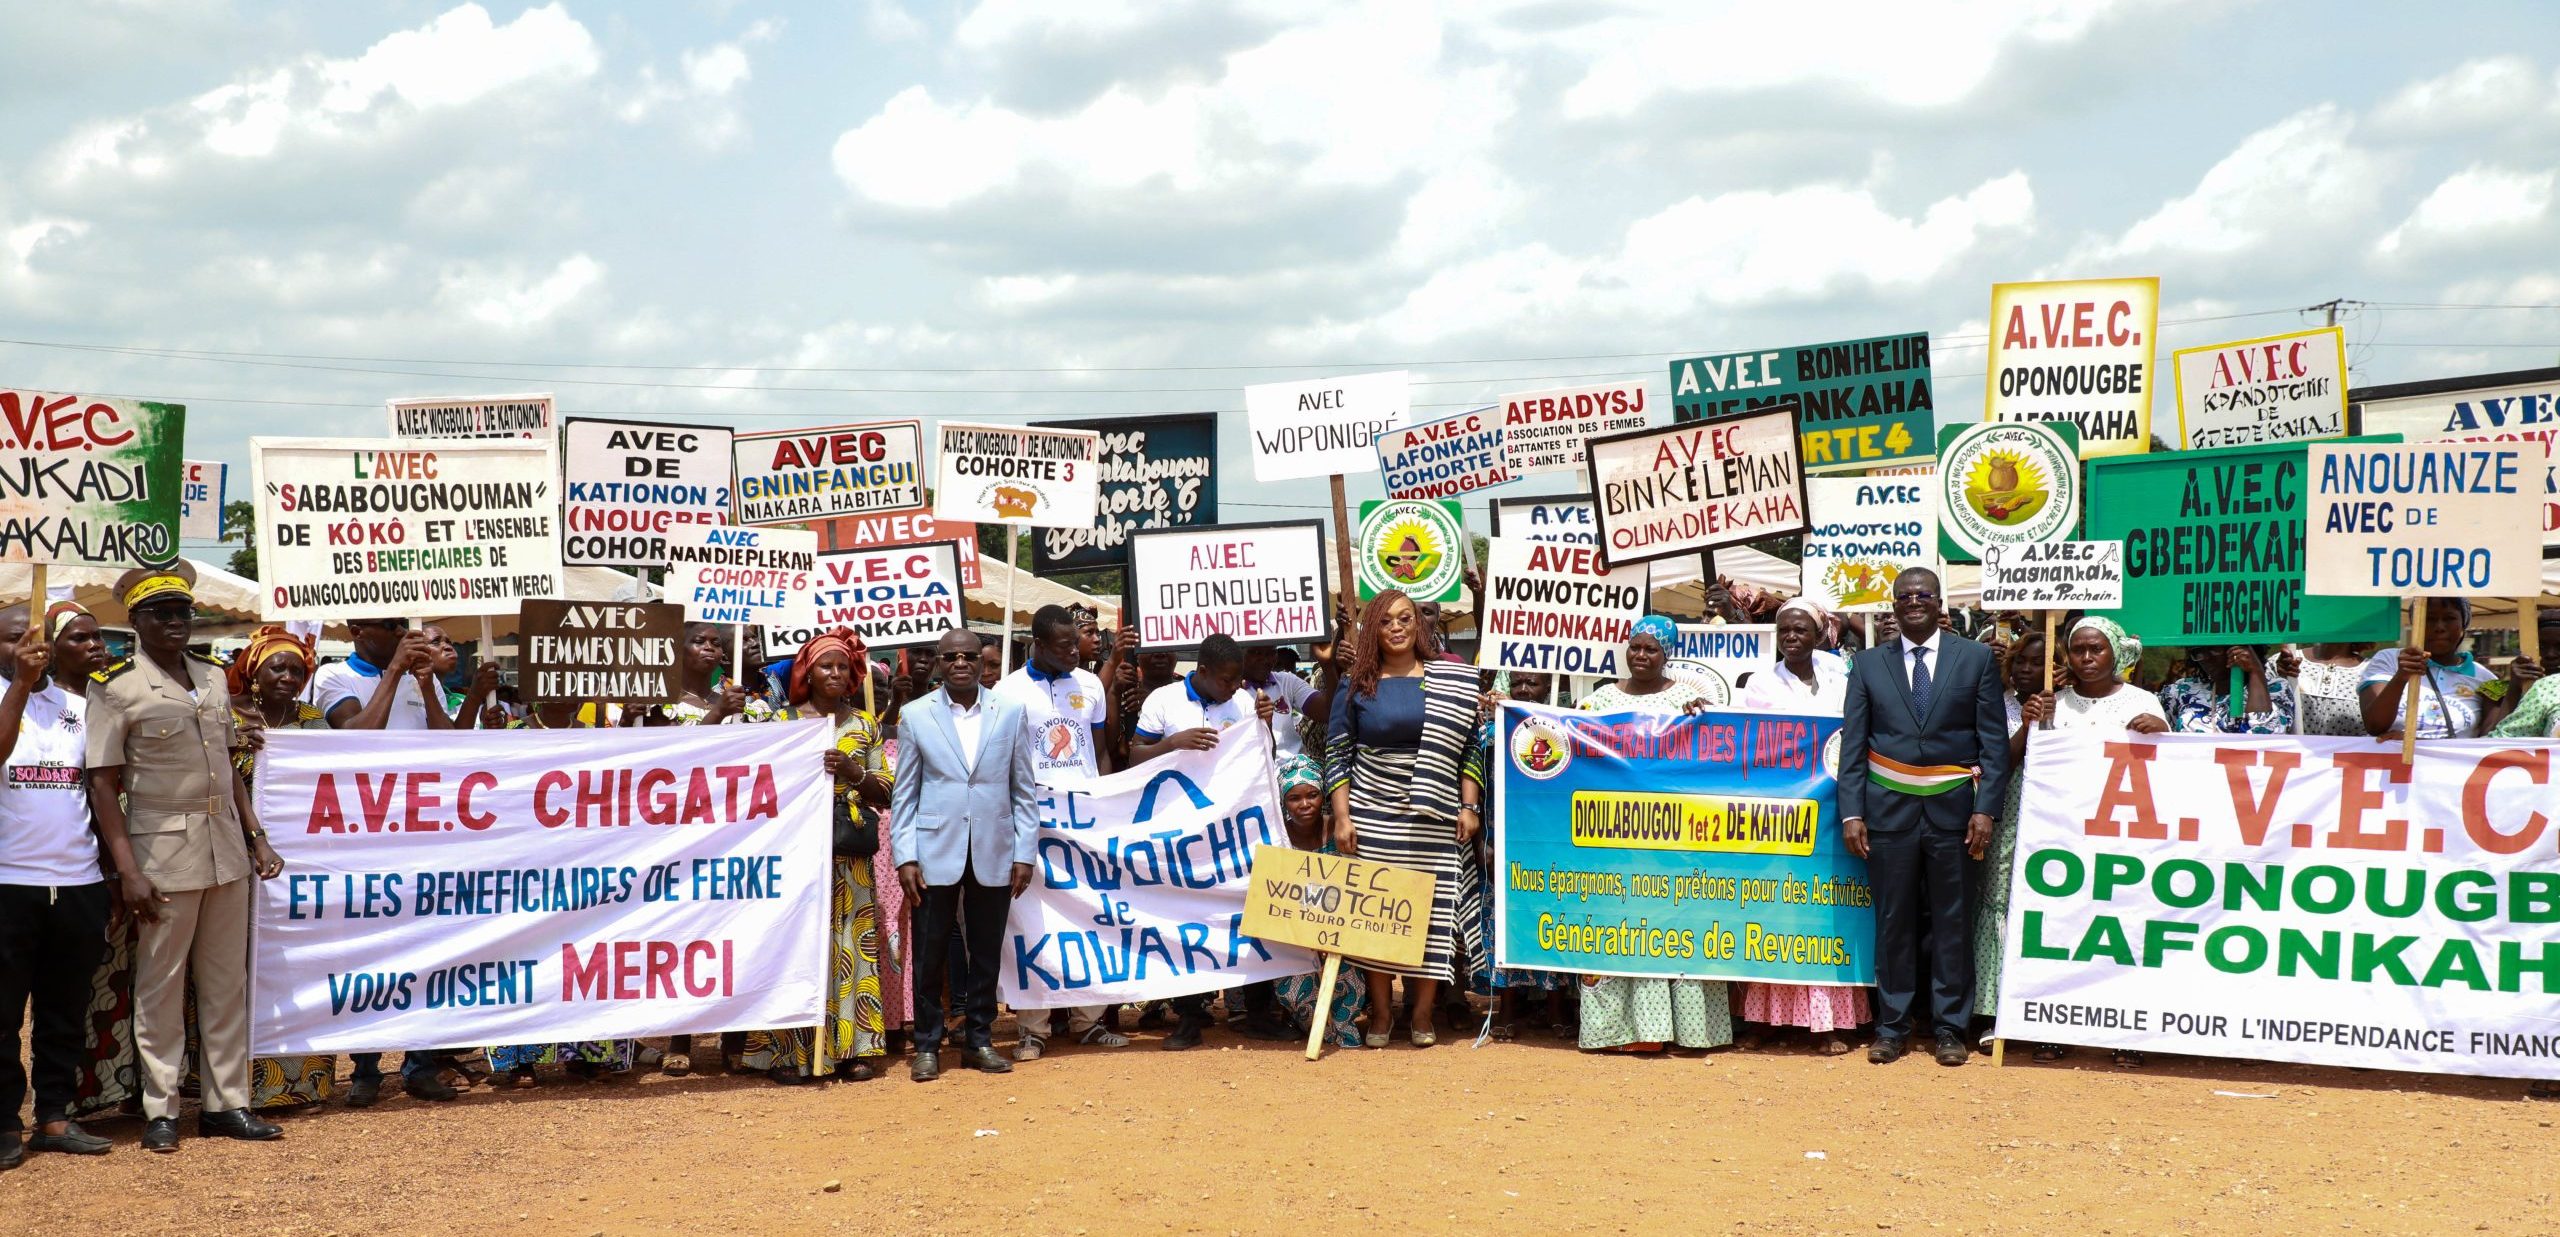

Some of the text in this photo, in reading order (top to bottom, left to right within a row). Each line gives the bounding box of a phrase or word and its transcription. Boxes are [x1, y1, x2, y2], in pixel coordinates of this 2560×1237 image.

[2003, 300, 2141, 349] A.V.E.C.
[1678, 335, 1931, 396] A.V.E.C BONHEUR
[2000, 364, 2142, 397] OPONOUGBE
[1298, 389, 1344, 411] AVEC
[1506, 388, 1644, 425] AFBADYSJ
[2257, 406, 2279, 422] DE
[0, 392, 134, 451] .V.E.C
[398, 403, 548, 435] A.V.E.C WOGBOLO 2 DE KATIONON 2
[1404, 415, 1481, 448] A.V.E.C
[1507, 424, 1573, 440] ASSOCIATION
[1579, 422, 1598, 433] DES
[1604, 417, 1646, 431] FEMMES
[607, 430, 698, 453] AVEC
[771, 432, 886, 471] AVEC
[944, 430, 1092, 461] A.V.E.C WOGBOLO 1 DE KATIONON 2
[1382, 428, 1503, 473] LAFONKAHA
[1508, 440, 1561, 454] BATTANTES
[1567, 438, 1578, 448] ET
[1653, 425, 1745, 472] AVEC
[1885, 422, 1912, 455] 4
[354, 451, 438, 480] L'AVEC
[625, 457, 680, 479] DE
[956, 455, 1075, 482] COHORTE 3
[1388, 452, 1493, 489] COHORTE
[1509, 454, 1565, 469] DE SAINTE
[2320, 451, 2518, 494] ANOUANZE
[185, 484, 207, 501] DE
[569, 483, 729, 508] KATIONON 2
[741, 461, 916, 501] GNINFANGUI
[1856, 485, 1921, 506] A.V.E.C
[2180, 460, 2297, 518] A.V.E.C
[744, 486, 920, 520] NIAKARA HABITAT 1
[2325, 502, 2437, 533] AVEC DE
[278, 523, 311, 546] DE
[426, 520, 456, 542] ET
[466, 516, 549, 540] L'ENSENBLE
[706, 529, 759, 547] AVEC
[855, 514, 935, 544] AVEC
[1612, 494, 1799, 550] OUNADIEKAHA
[1812, 521, 1922, 538] WOWOTCHO
[0, 516, 173, 568] AKALAKRO
[1191, 542, 1255, 571] A.V.E.C
[1804, 541, 1921, 558] DE KOWARA
[2021, 542, 2095, 561] A.V.E.C
[333, 546, 508, 574] DES BENEFICIAIRES DE
[2367, 547, 2491, 588] TOURO
[423, 578, 456, 600] VOUS
[460, 576, 509, 599] DISENT
[513, 574, 553, 597] MERCI
[698, 568, 807, 591] COHORTE 6
[1495, 577, 1639, 610] WOWOTCHO
[1983, 586, 2028, 601] aime
[560, 606, 647, 630] AVEC
[702, 608, 750, 622] UNIE
[2183, 579, 2300, 635] EMERGENCE
[530, 635, 675, 666] FEMMES UNIES
[1500, 641, 1617, 675] KATIOLA
[537, 671, 668, 697] DE PEDIAKAHA
[1575, 721, 1693, 762] FEDERATION
[1701, 722, 1736, 763] DES
[1754, 720, 1807, 770] AVEC
[1051, 759, 1083, 769] KOWARA
[306, 763, 780, 835] A.V.E.C CHIGATA
[1575, 800, 1682, 841] DIOULABOUGOU
[1713, 815, 1720, 842] 2
[1726, 803, 1746, 842] DE
[1750, 804, 1811, 843] KATIOLA
[289, 855, 782, 921] ET LES BENEFICIAIRES DE FERKE
[1297, 855, 1391, 892] AVEC
[1511, 861, 1872, 909] Nous épargnons, nous prêtons pour des Activités
[1093, 893, 1136, 927] de
[1266, 879, 1412, 923] WOWOTCHO
[1268, 903, 1412, 937] DE TOURO GROUPE
[1318, 930, 1340, 947] 01
[1538, 913, 1851, 966] Génératrices de Revenus.
[328, 972, 416, 1016] VOUS
[562, 938, 733, 1002] MERCI
[2024, 1001, 2148, 1031] ENSEMBLE
[2162, 1012, 2228, 1038] POUR
[2242, 1018, 2455, 1054] L'INDEPENDANCE
